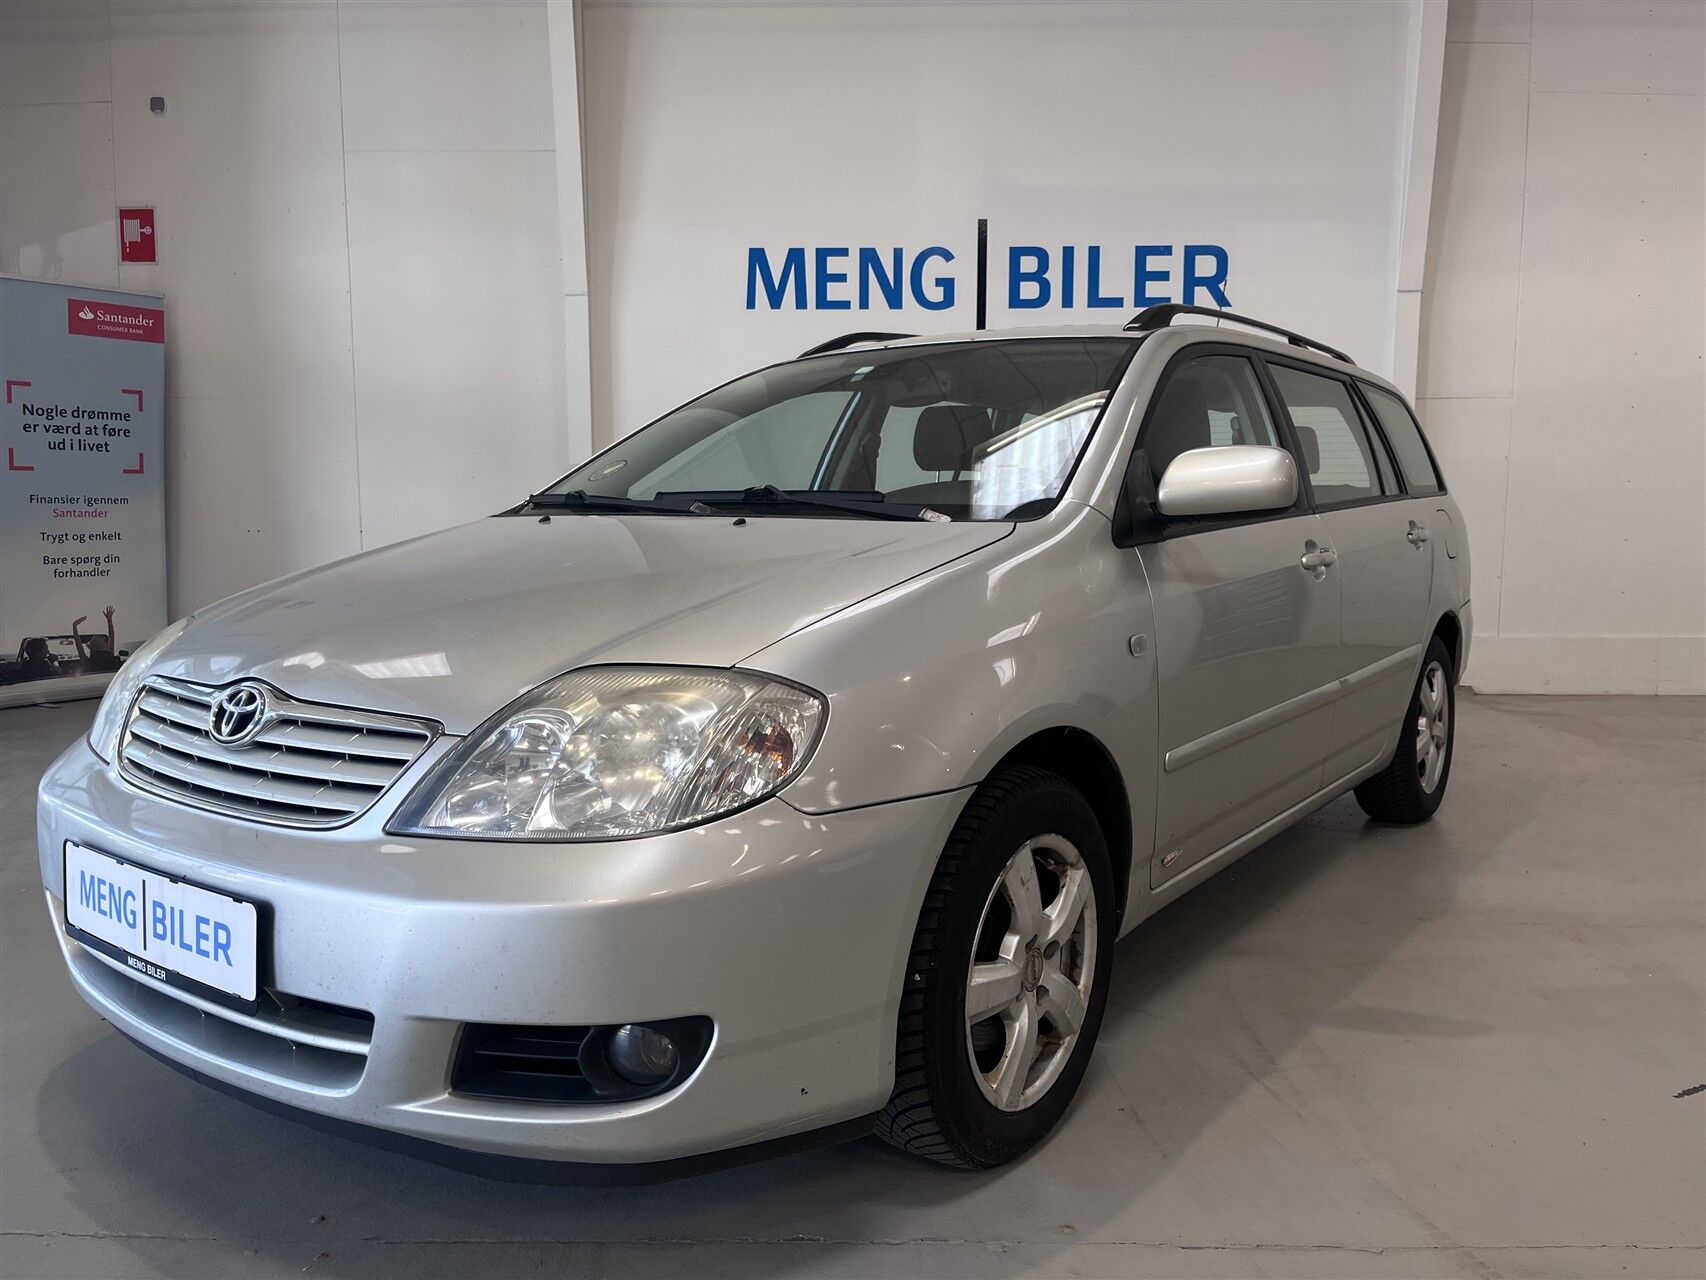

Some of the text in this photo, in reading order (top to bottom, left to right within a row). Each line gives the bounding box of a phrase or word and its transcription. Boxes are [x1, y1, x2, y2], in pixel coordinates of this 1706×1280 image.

[746, 245, 1233, 310] MENG BILER
[97, 310, 154, 327] Santander
[97, 324, 128, 333] CONSUMER
[22, 403, 131, 421] Nogle drømme
[22, 423, 131, 437] er værd at føre
[48, 438, 110, 452] ud i livet
[29, 494, 129, 507] Finansier igennem
[53, 508, 109, 519] Santander
[40, 531, 122, 544] Trygt og enkelt
[43, 554, 120, 566] Bare spørg din
[53, 567, 110, 578] forhandler
[80, 870, 233, 967] MENG BILER
[127, 955, 166, 981] MENG BILER
